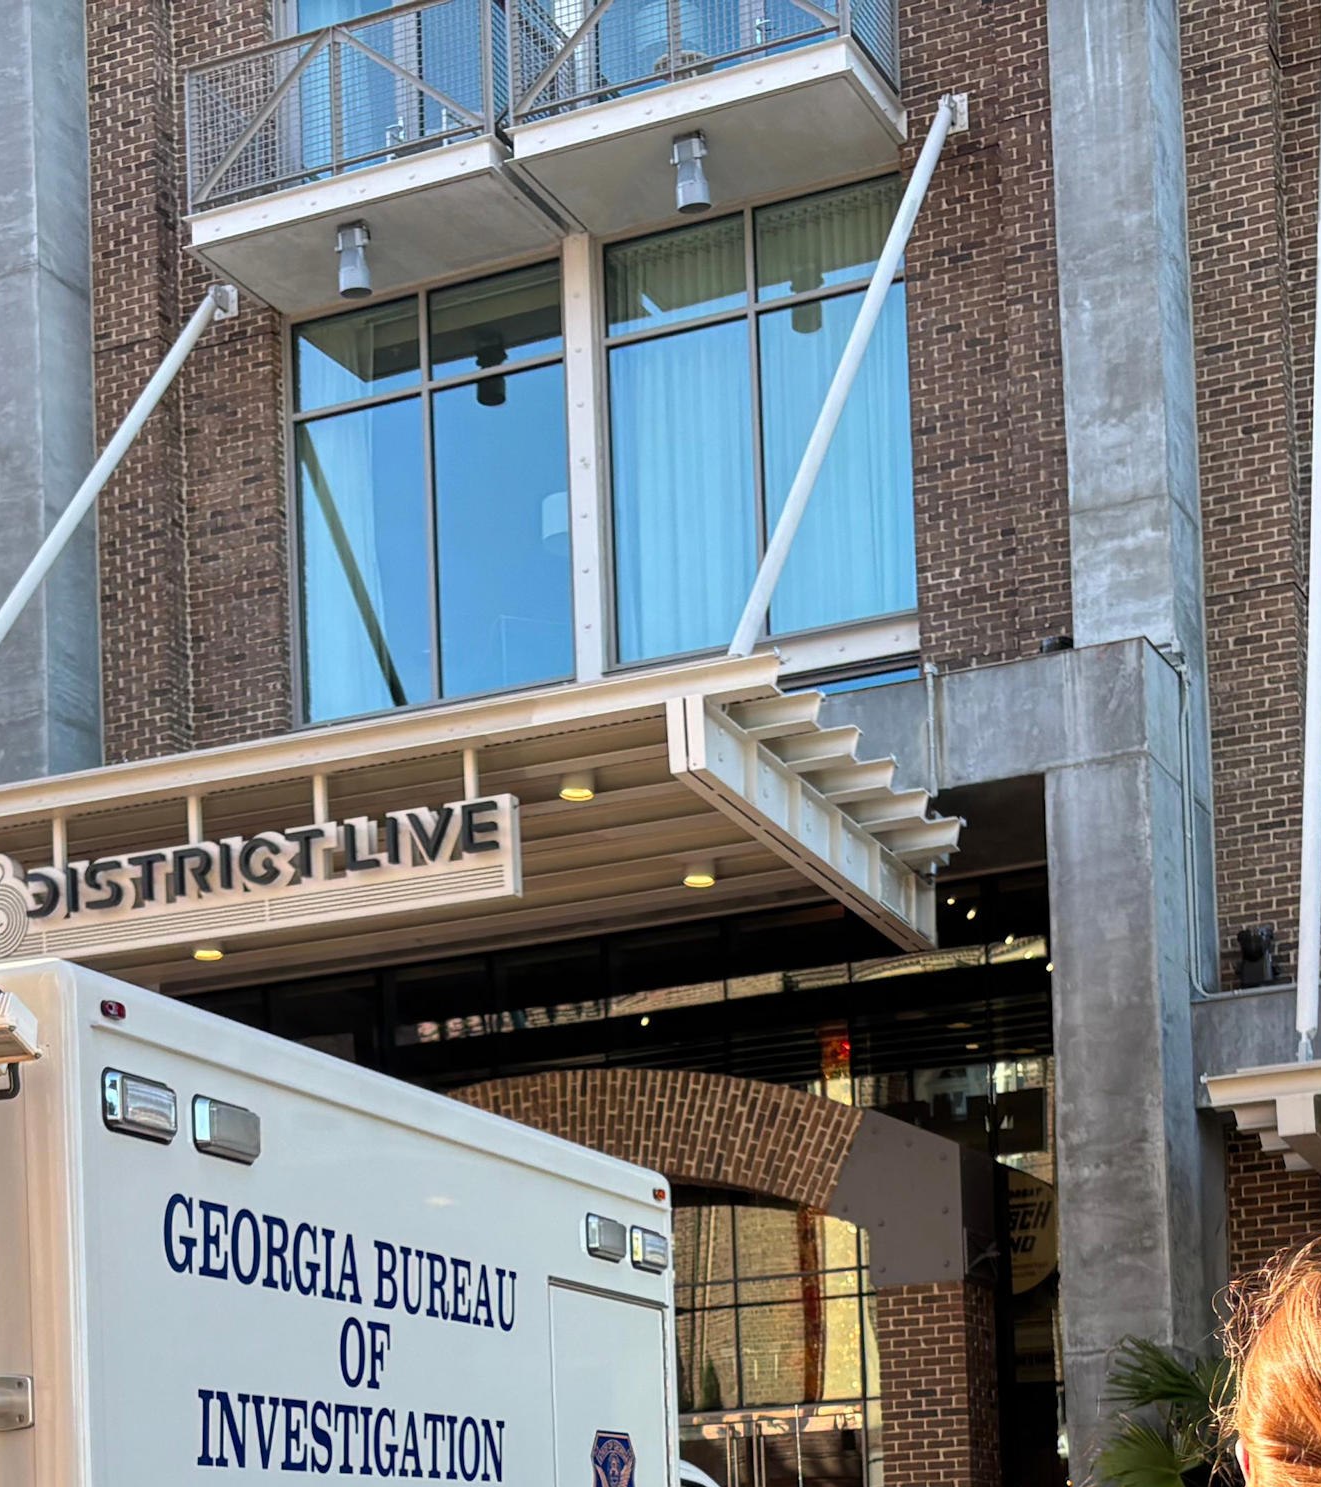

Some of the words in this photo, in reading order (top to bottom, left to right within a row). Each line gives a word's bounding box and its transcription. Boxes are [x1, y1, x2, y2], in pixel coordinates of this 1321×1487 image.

[25, 829, 324, 919] DISTRICT
[343, 799, 500, 871] LIVE
[163, 1192, 362, 1304] GEORGIA
[373, 1239, 517, 1332] BUREAU
[339, 1316, 391, 1390] OF
[196, 1389, 506, 1483] INVESTIGATION
